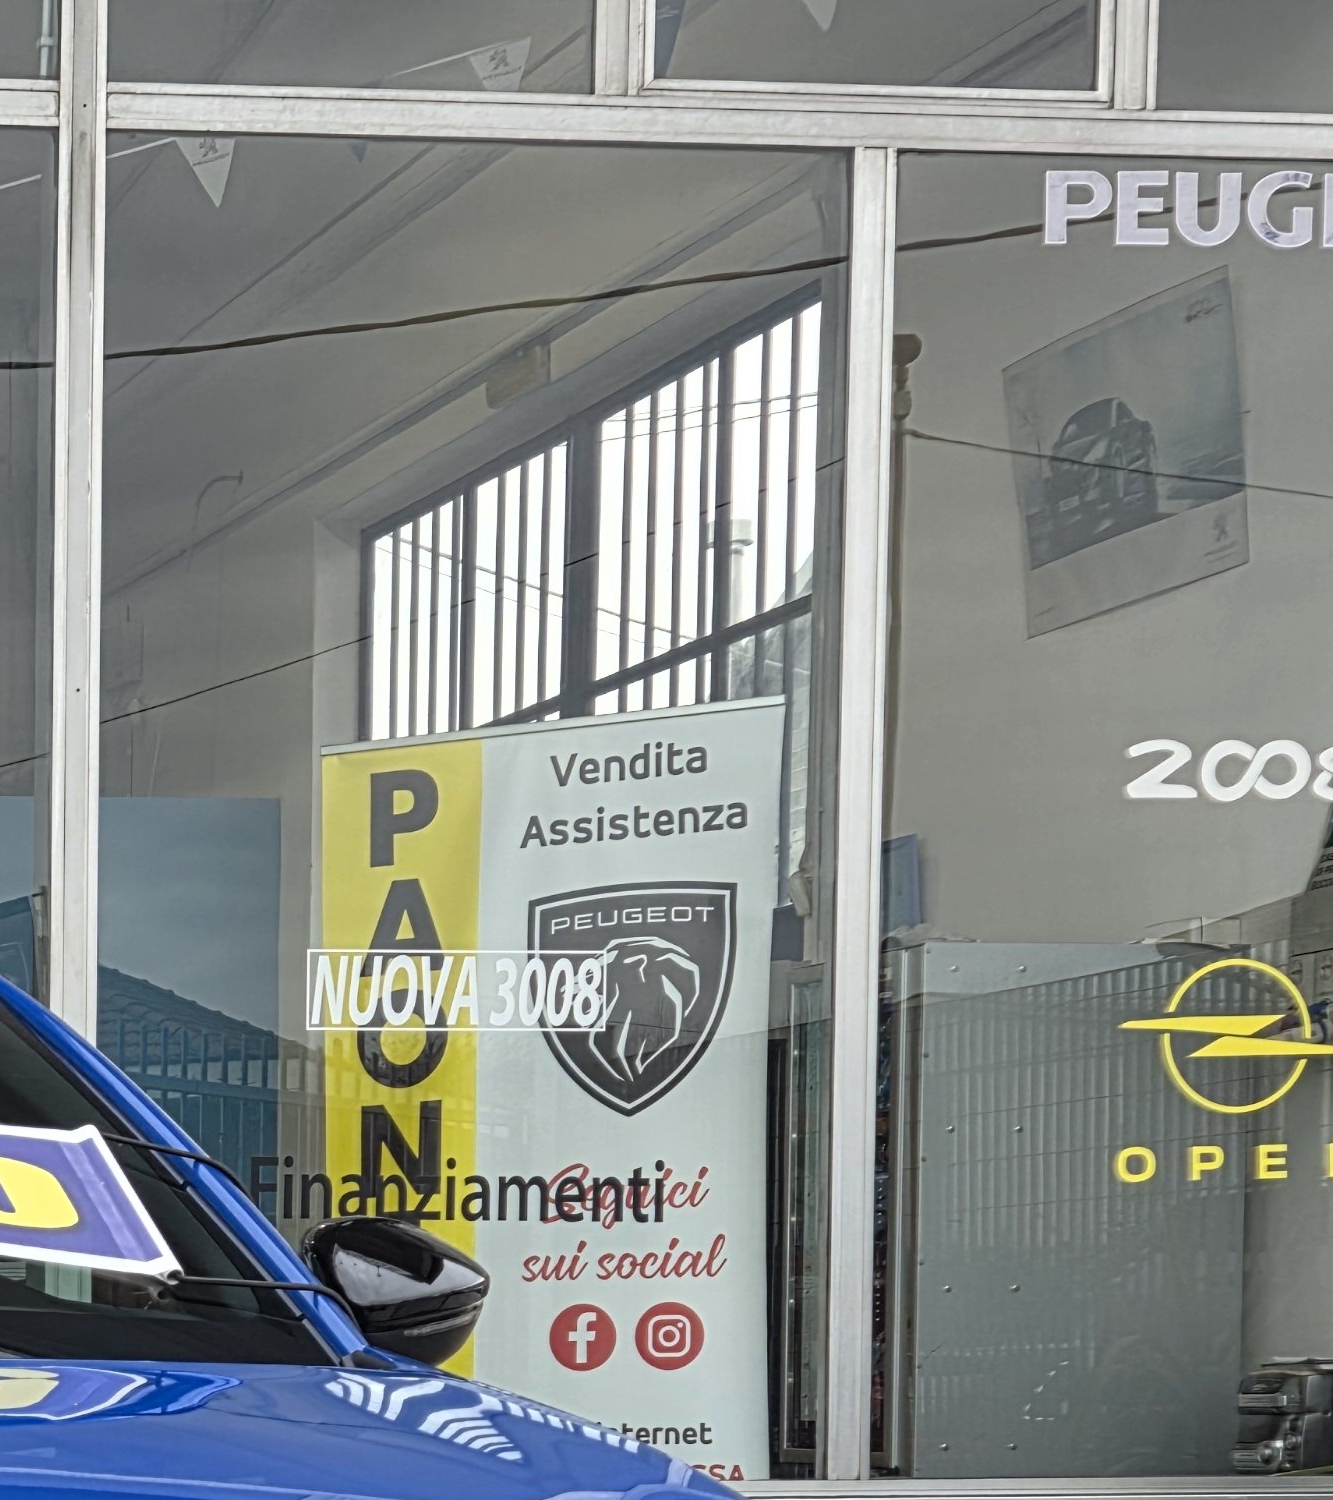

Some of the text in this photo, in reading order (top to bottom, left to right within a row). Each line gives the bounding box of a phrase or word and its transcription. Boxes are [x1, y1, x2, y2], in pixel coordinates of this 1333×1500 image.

[550, 742, 708, 787] Vendita
[519, 801, 749, 849] Assistenza
[550, 905, 715, 936] PEUGEOT
[310, 953, 604, 1028] NUOVA 3008
[250, 1155, 666, 1224] Finanziamenti
[521, 1233, 728, 1283] sui social
[597, 1421, 713, 1446] ternet
